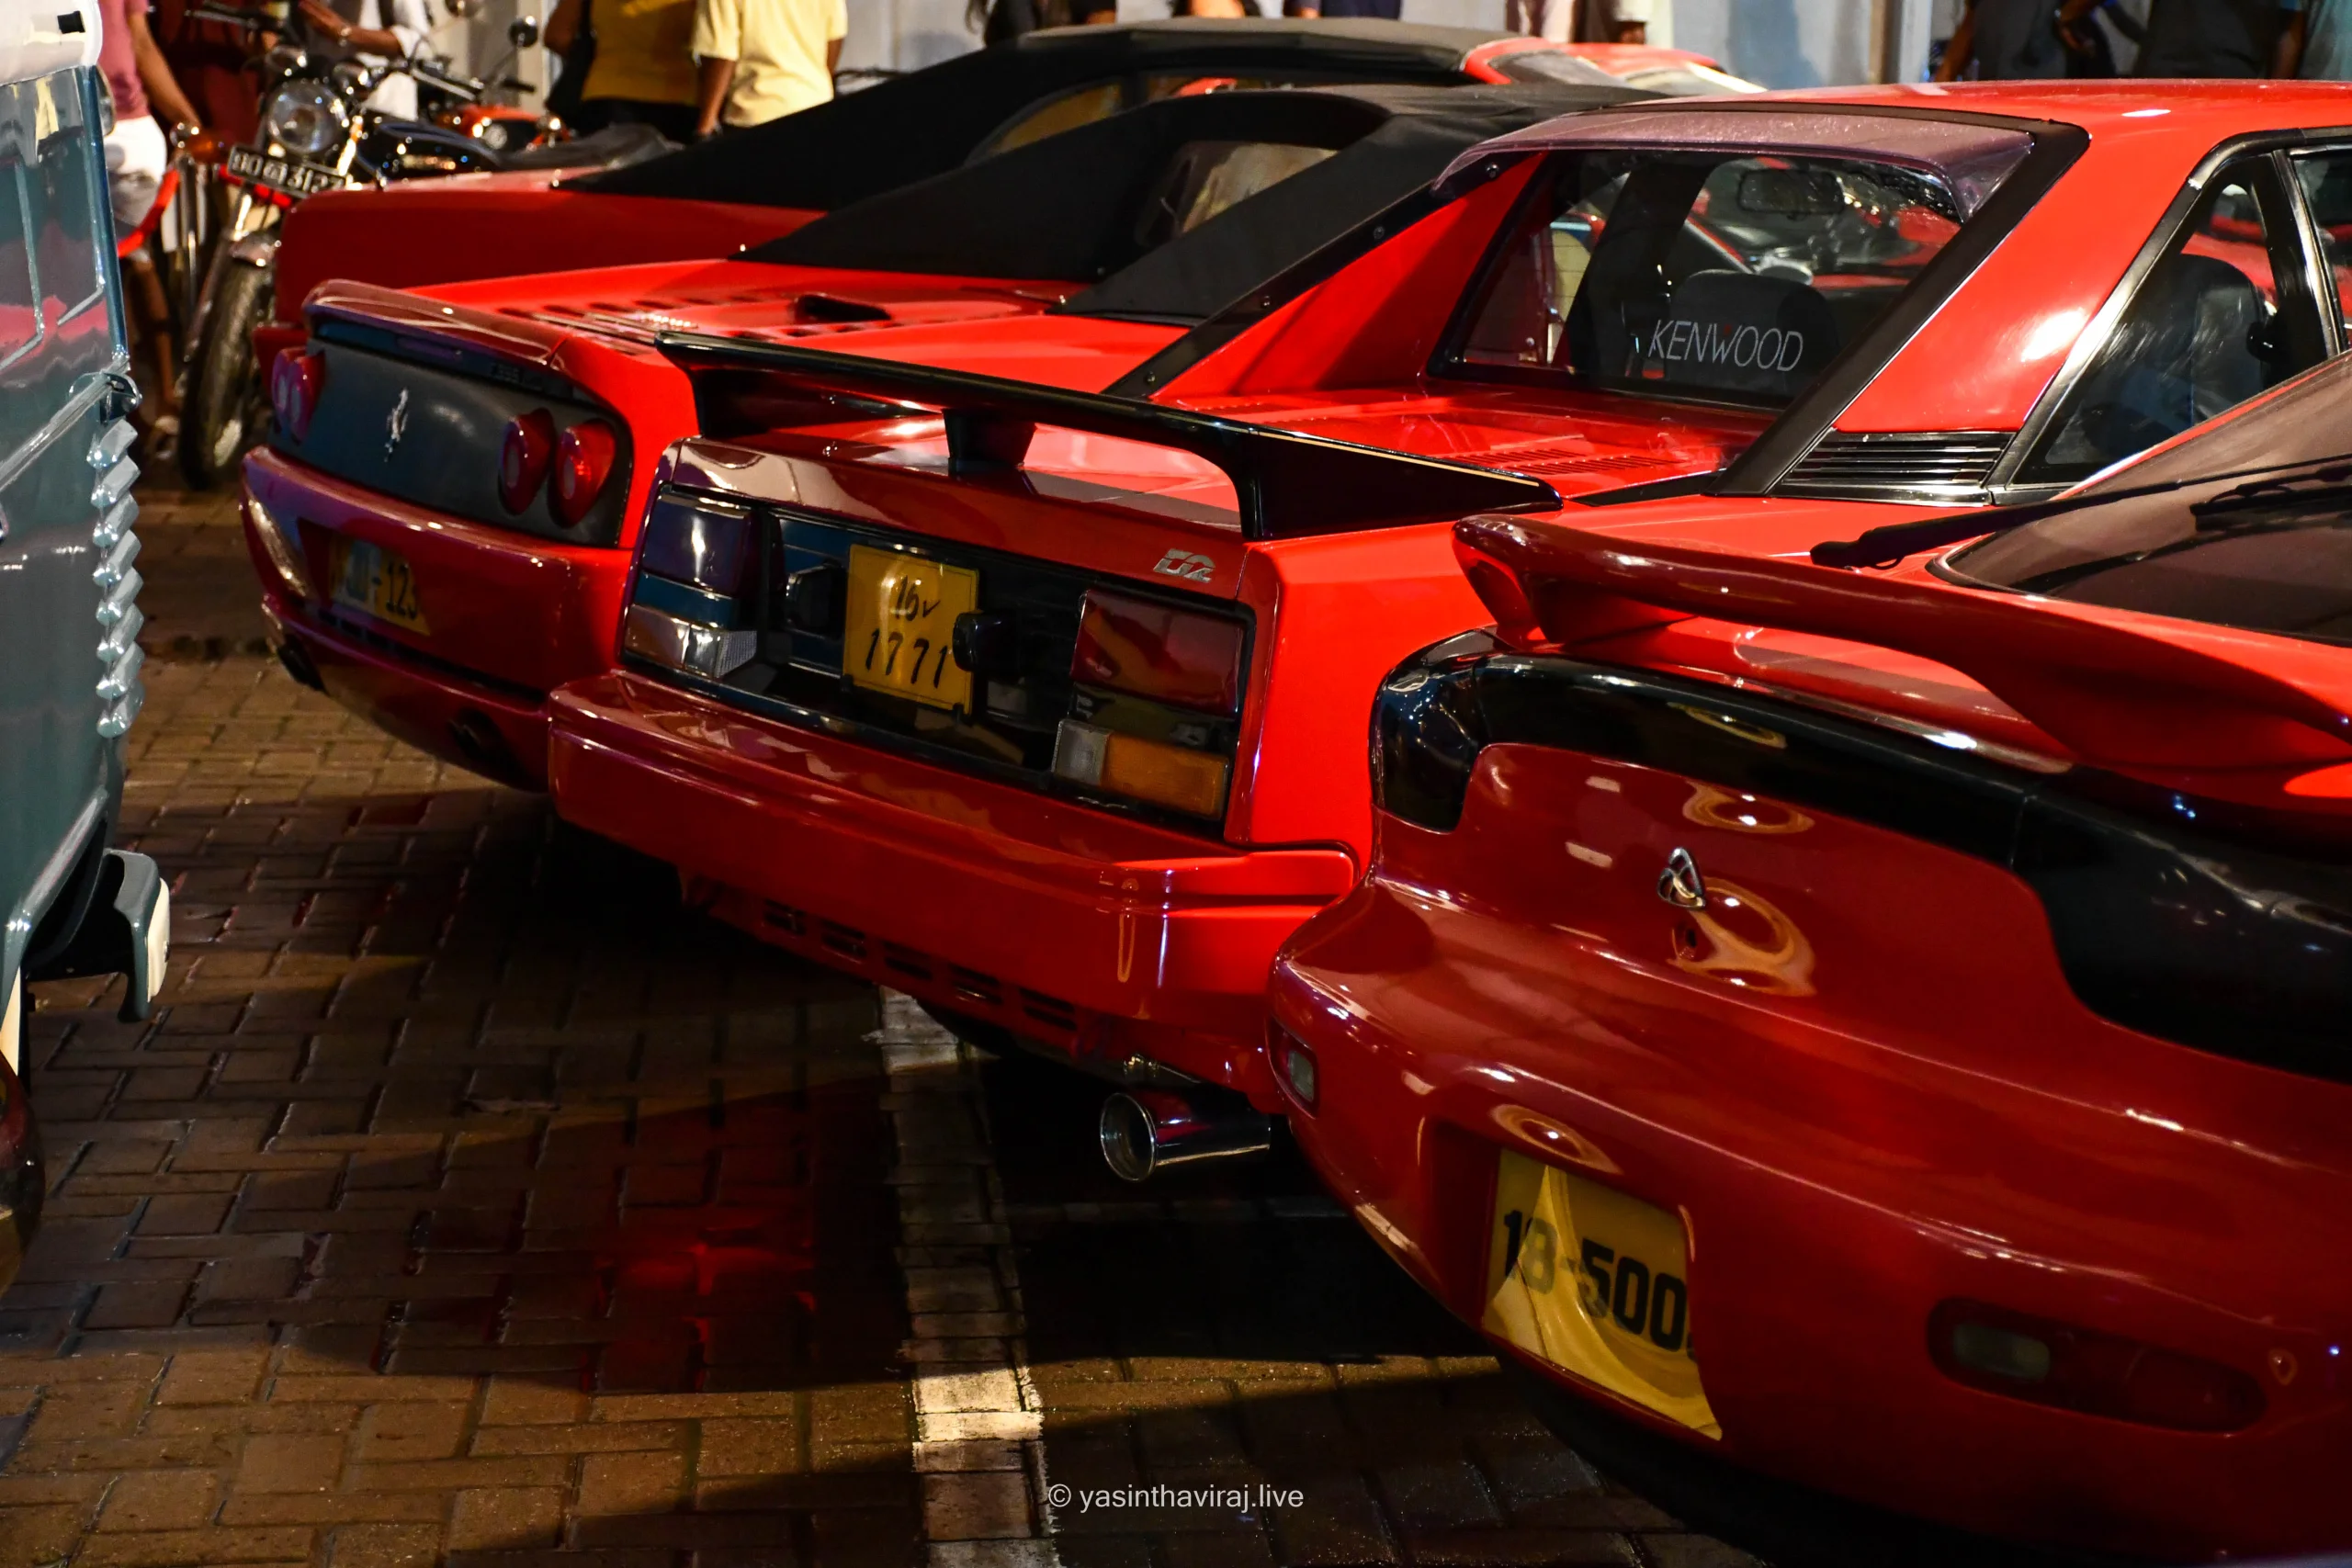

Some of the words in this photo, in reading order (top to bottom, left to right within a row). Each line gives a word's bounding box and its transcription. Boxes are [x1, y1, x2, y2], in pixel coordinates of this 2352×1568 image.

[1647, 319, 1804, 372] KENWOOD
[865, 627, 949, 689] 1771
[1503, 1209, 1697, 1363] 18-500
